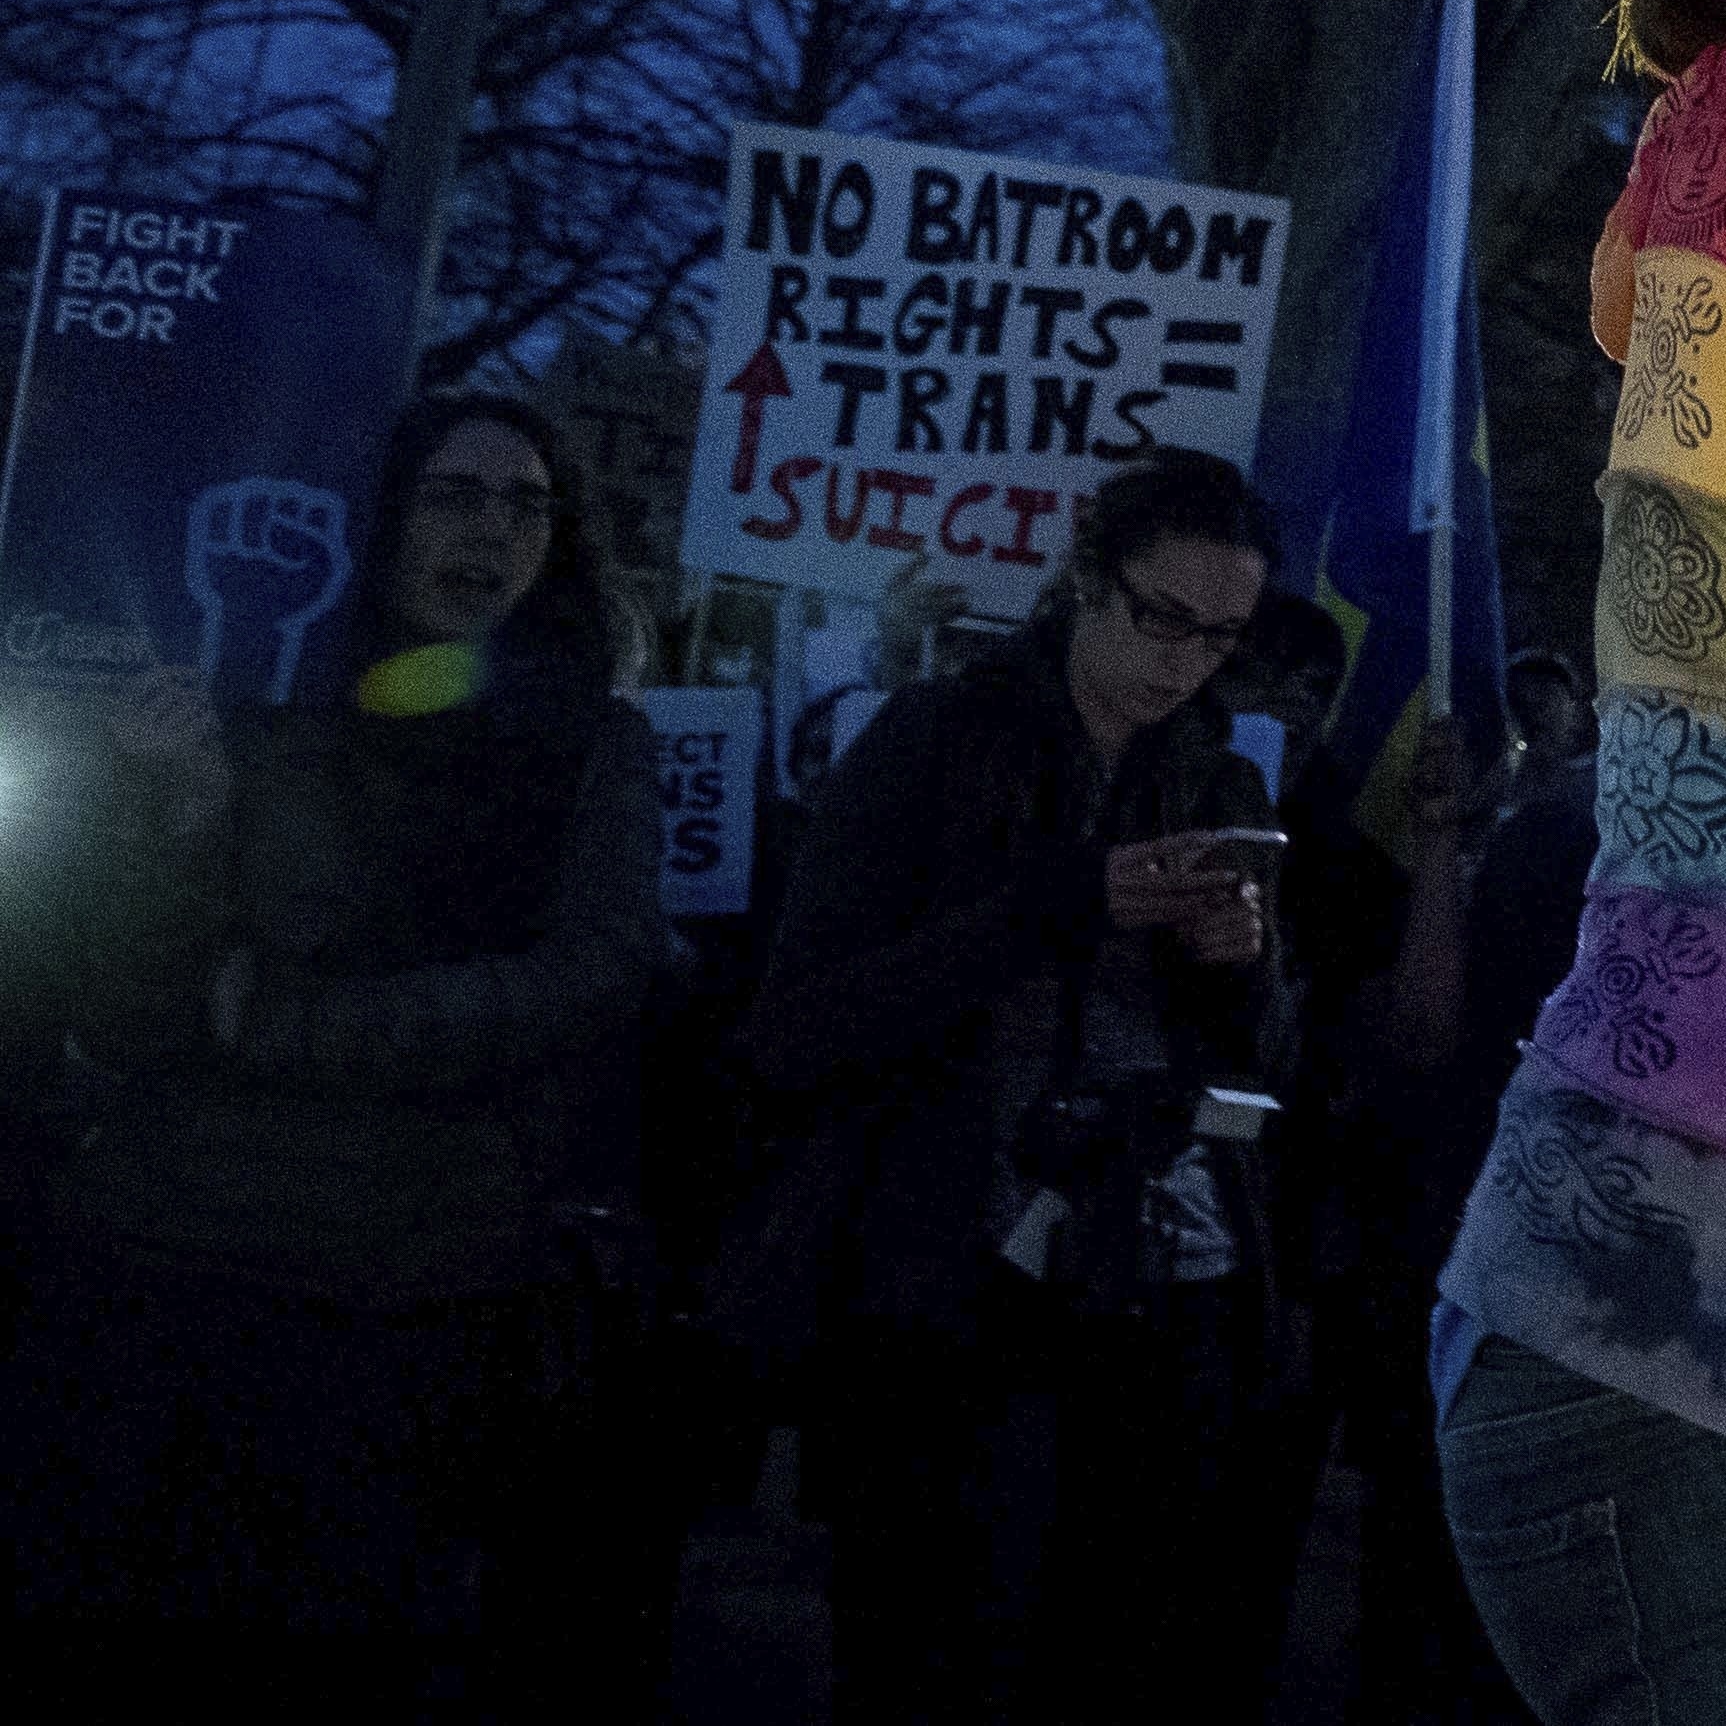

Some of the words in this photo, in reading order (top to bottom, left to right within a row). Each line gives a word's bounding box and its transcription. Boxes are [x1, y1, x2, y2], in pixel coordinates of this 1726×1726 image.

[67, 204, 247, 259] FIGHT
[744, 150, 873, 258] NO
[906, 167, 1274, 286] BATROOM
[53, 297, 176, 343] FOR
[60, 250, 222, 303] BACK
[767, 265, 1153, 368] RIGHTS
[821, 362, 1168, 461] TRANS
[741, 457, 1095, 566] SUICI
